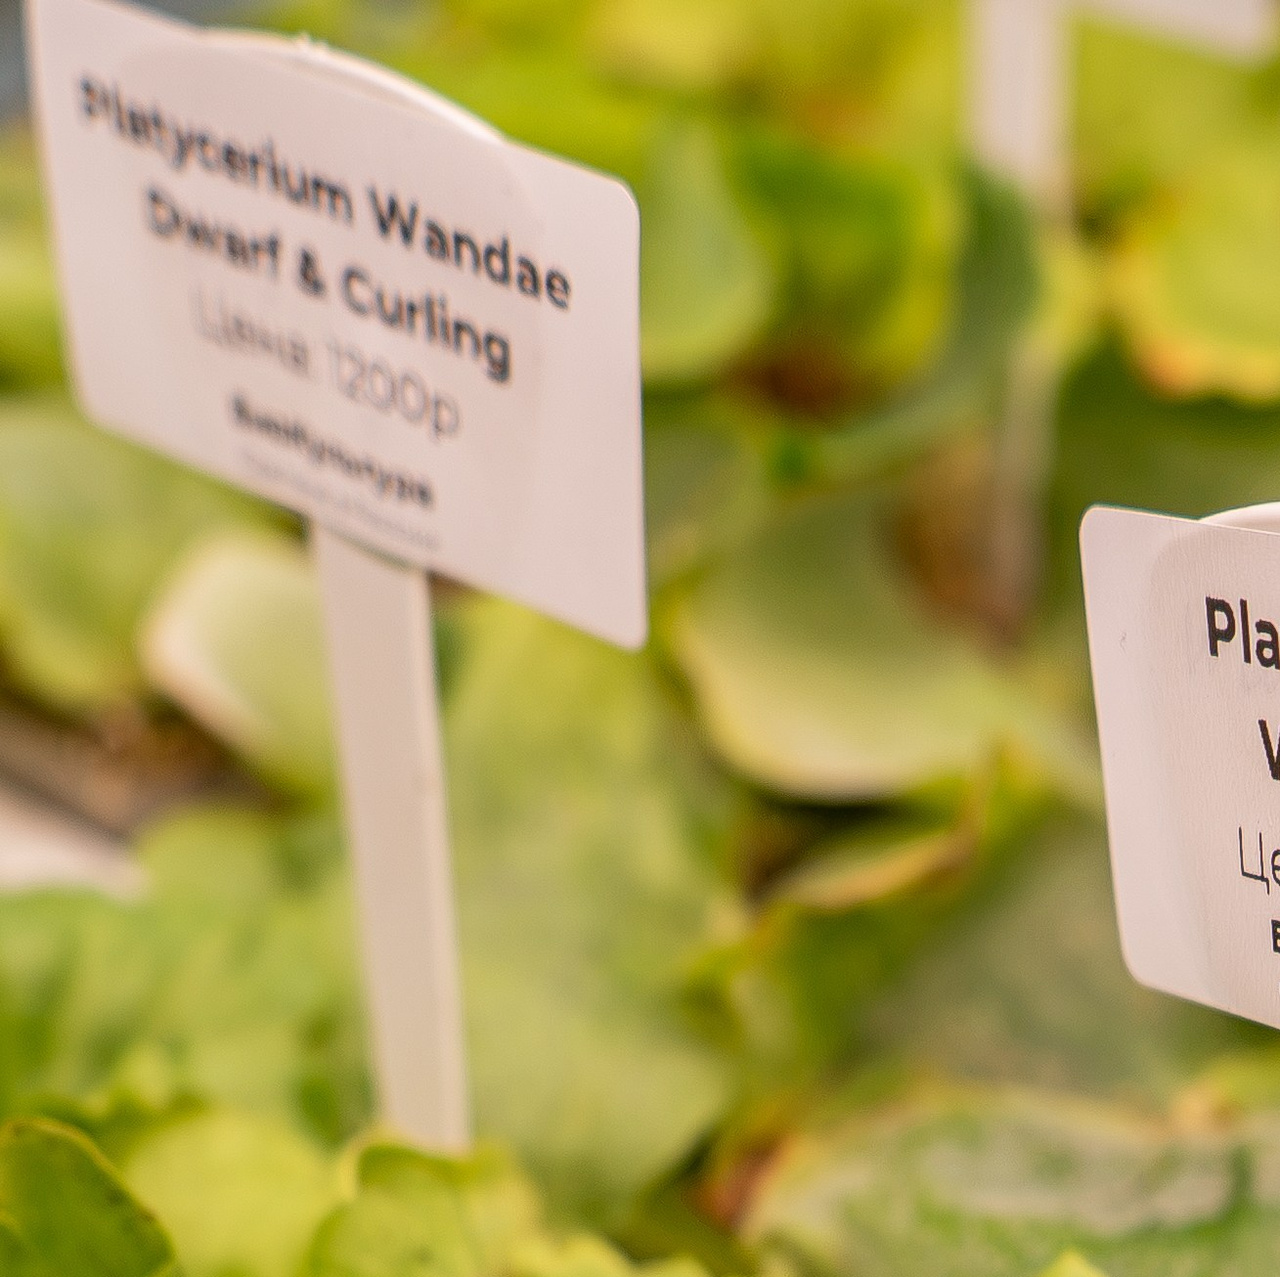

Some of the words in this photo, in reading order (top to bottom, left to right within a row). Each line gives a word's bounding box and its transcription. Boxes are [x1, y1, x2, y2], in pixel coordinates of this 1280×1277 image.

[80, 76, 354, 224] Platycerium
[368, 184, 573, 311] Wandae
[147, 188, 281, 276] Dwarf
[298, 249, 327, 298] &
[343, 267, 513, 383] Curling
